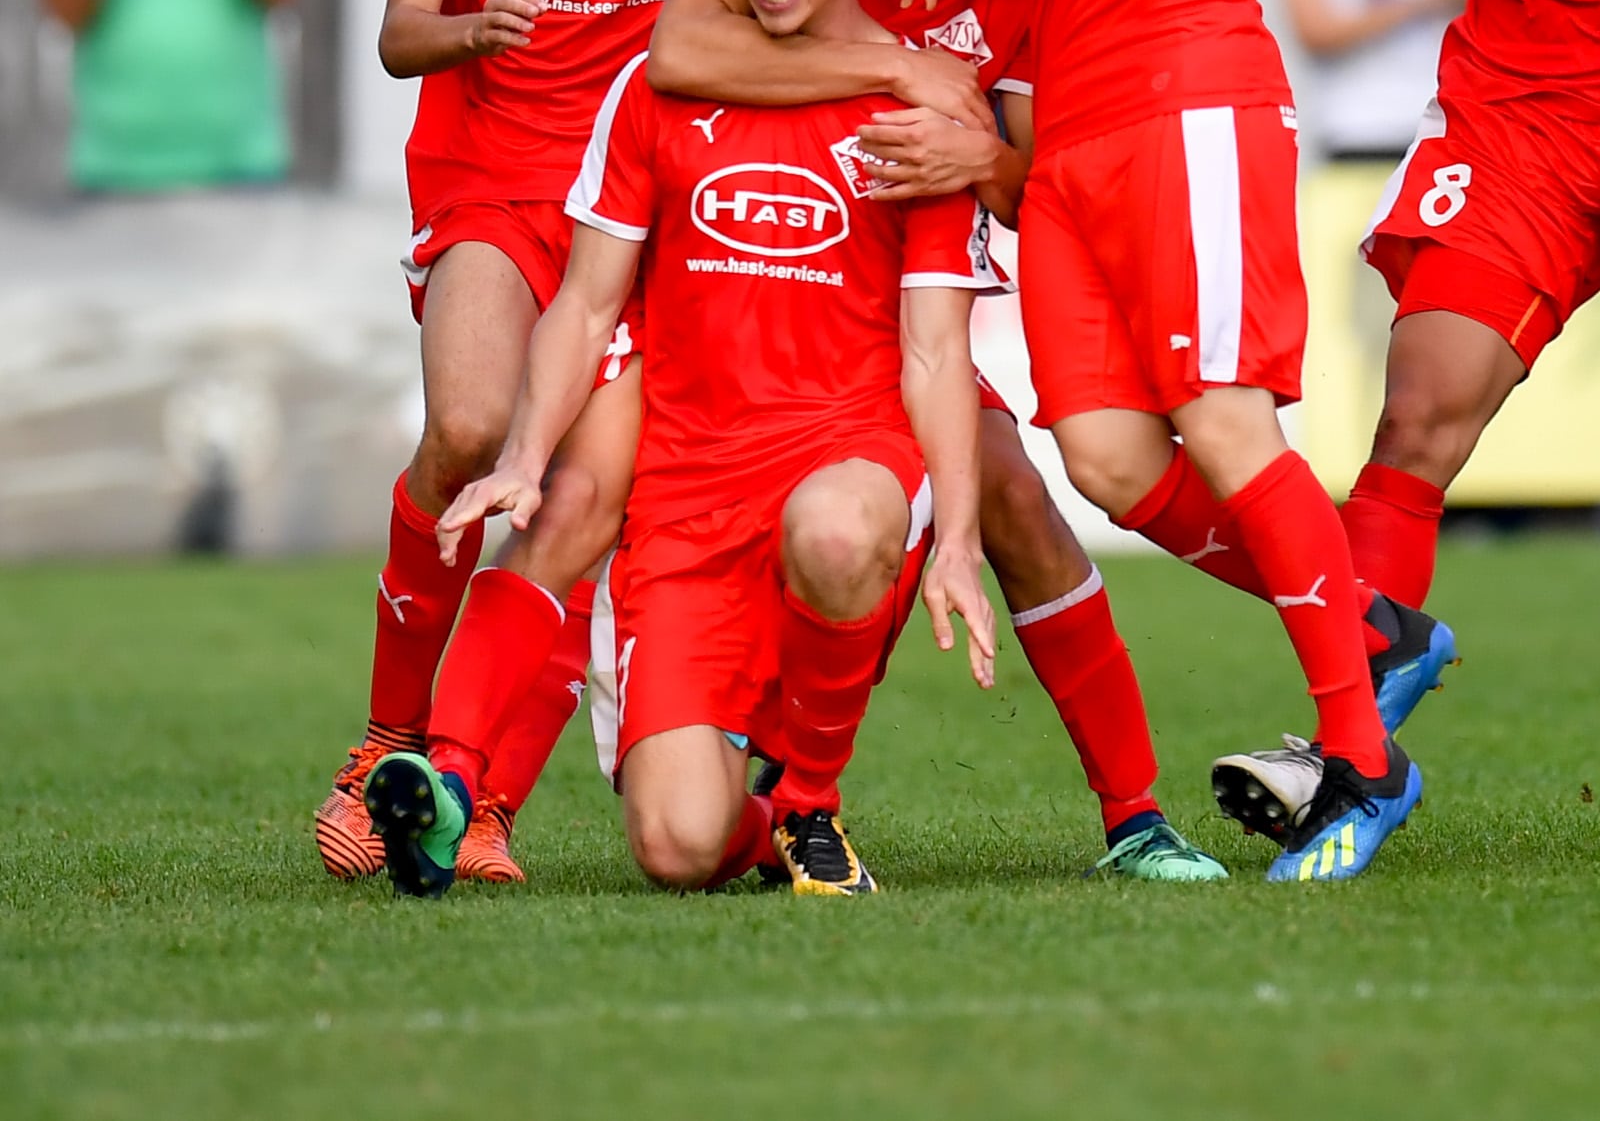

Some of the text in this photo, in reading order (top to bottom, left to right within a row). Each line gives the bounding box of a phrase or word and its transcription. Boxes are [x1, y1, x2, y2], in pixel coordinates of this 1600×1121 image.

[939, 21, 982, 49] ATSV
[703, 189, 838, 231] HAST
[1419, 163, 1473, 228] 8
[686, 256, 844, 287] www.hast-service.at
